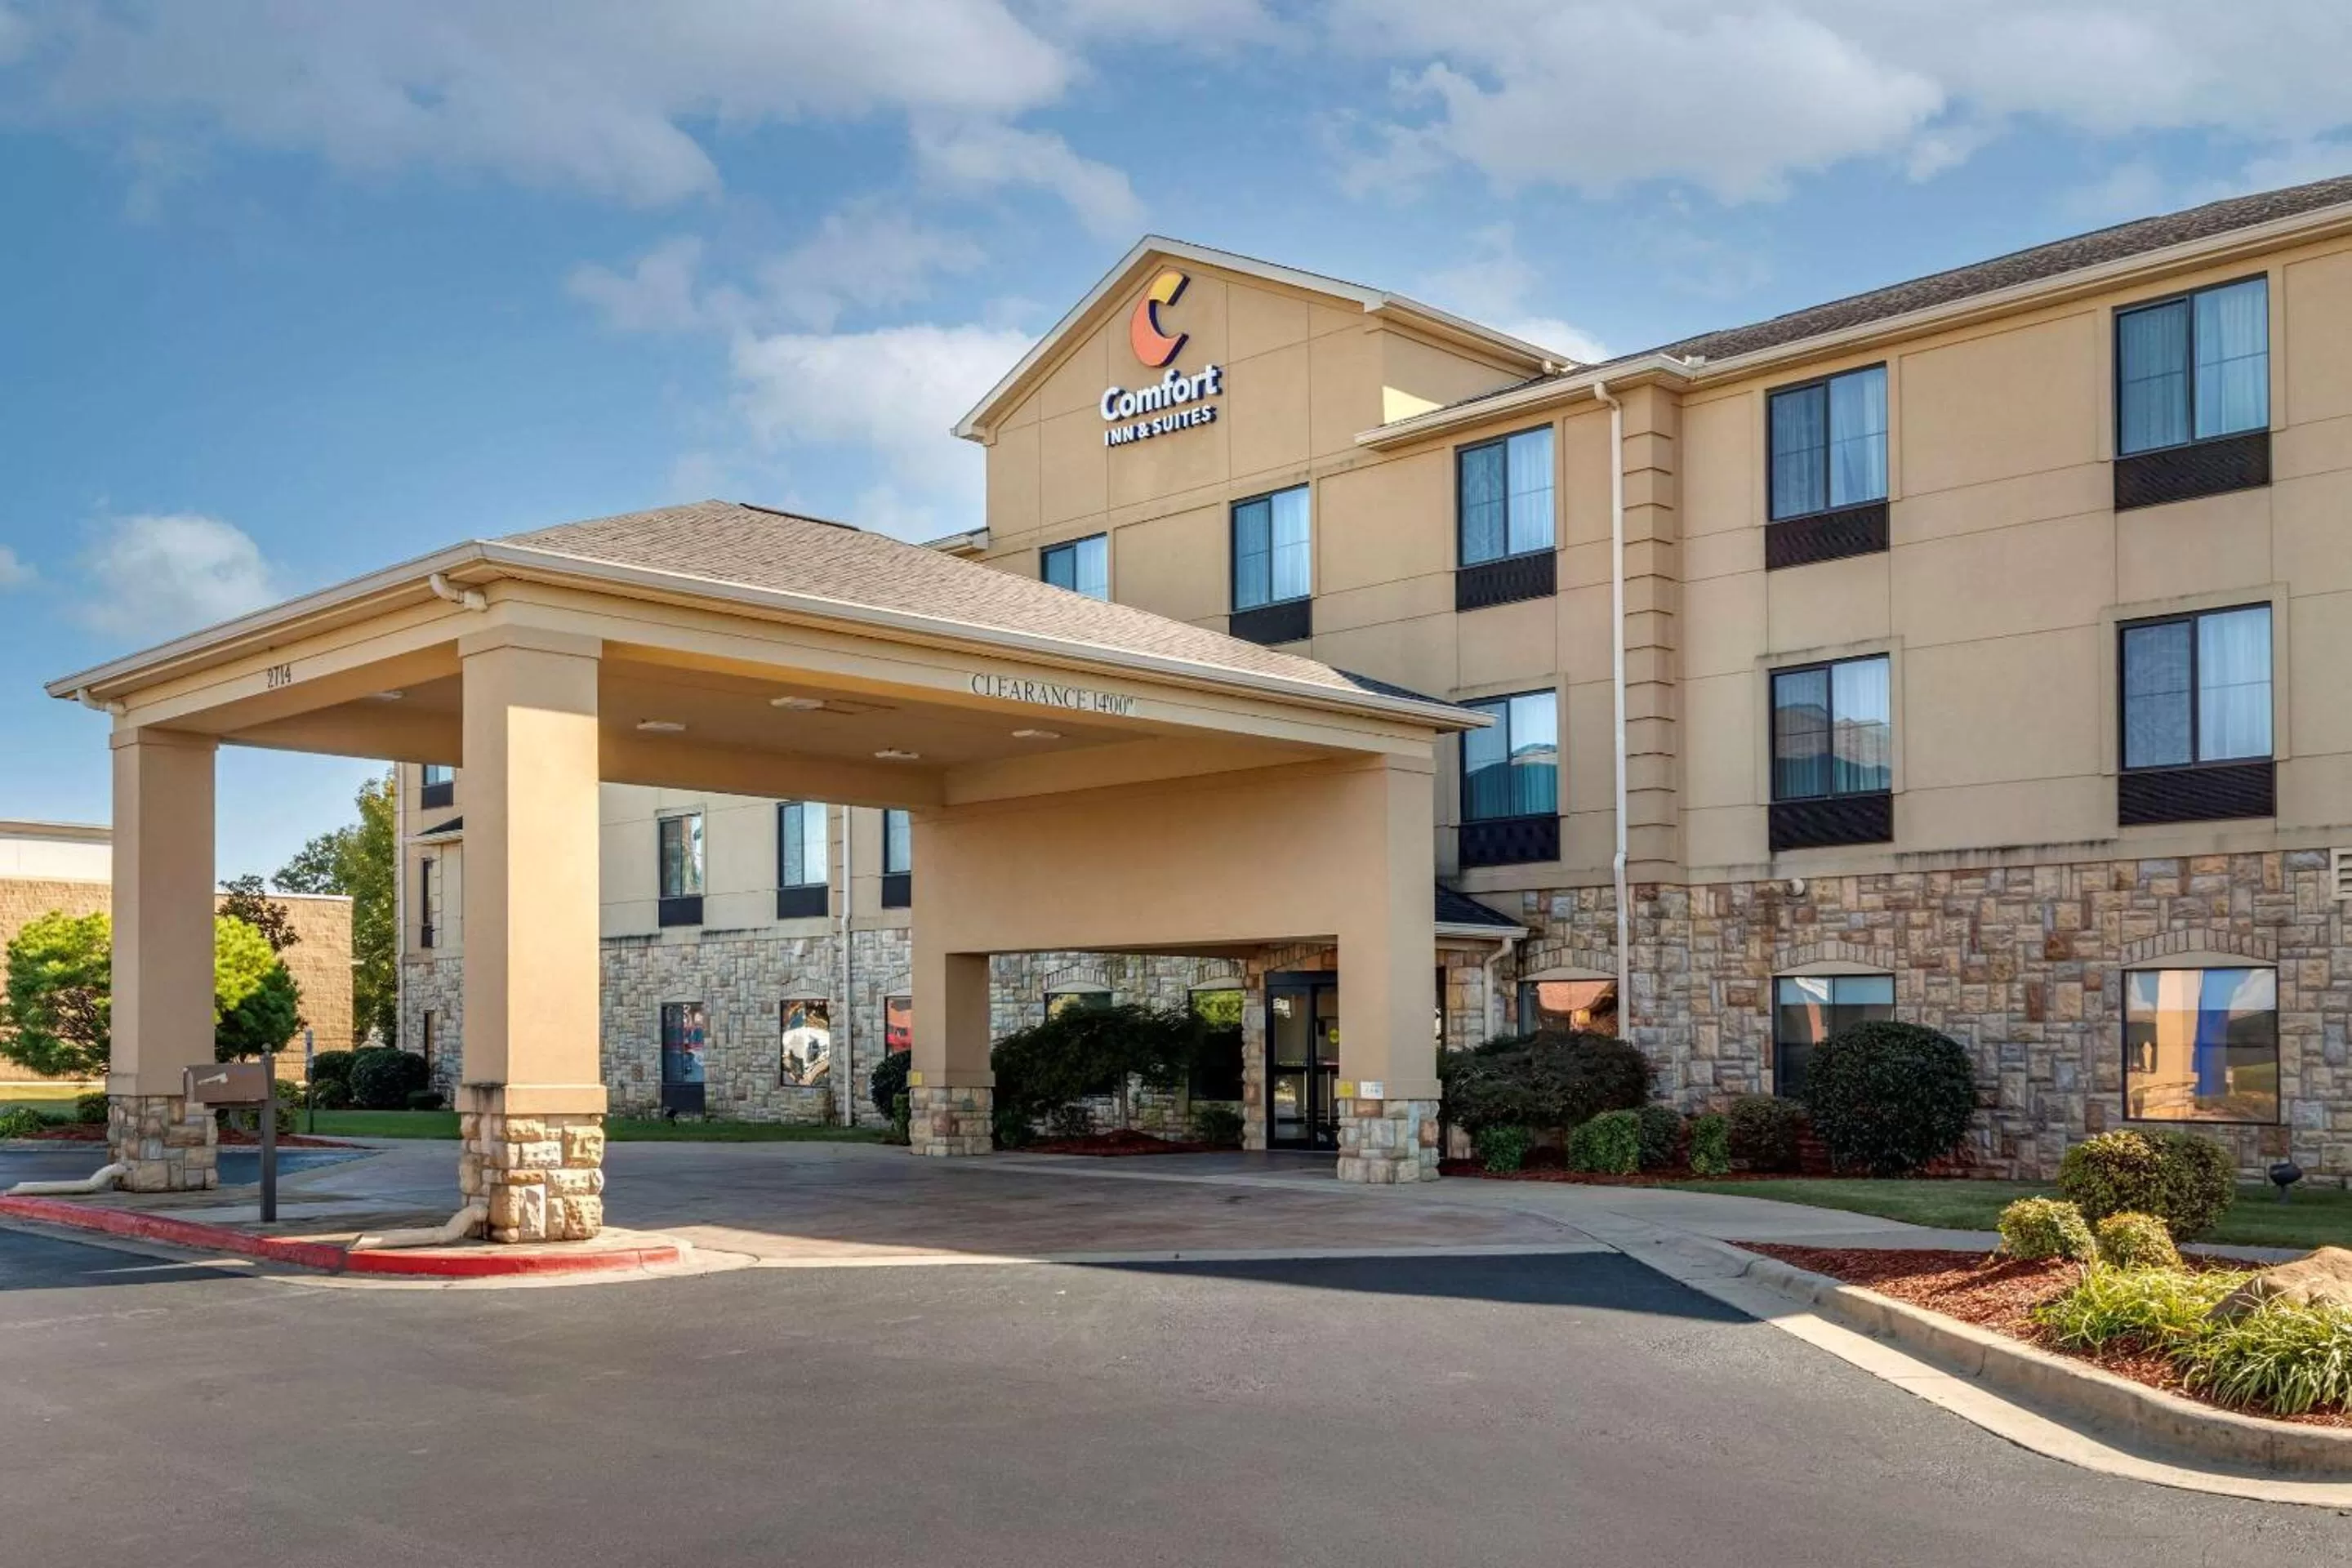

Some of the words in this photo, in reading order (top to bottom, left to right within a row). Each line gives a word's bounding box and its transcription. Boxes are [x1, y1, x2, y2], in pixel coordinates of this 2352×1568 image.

[1100, 364, 1223, 421] Comfort
[1104, 424, 1136, 447] INN
[1138, 421, 1152, 439] &
[1152, 405, 1217, 433] SUITES
[972, 673, 1087, 710] CLEARANCE
